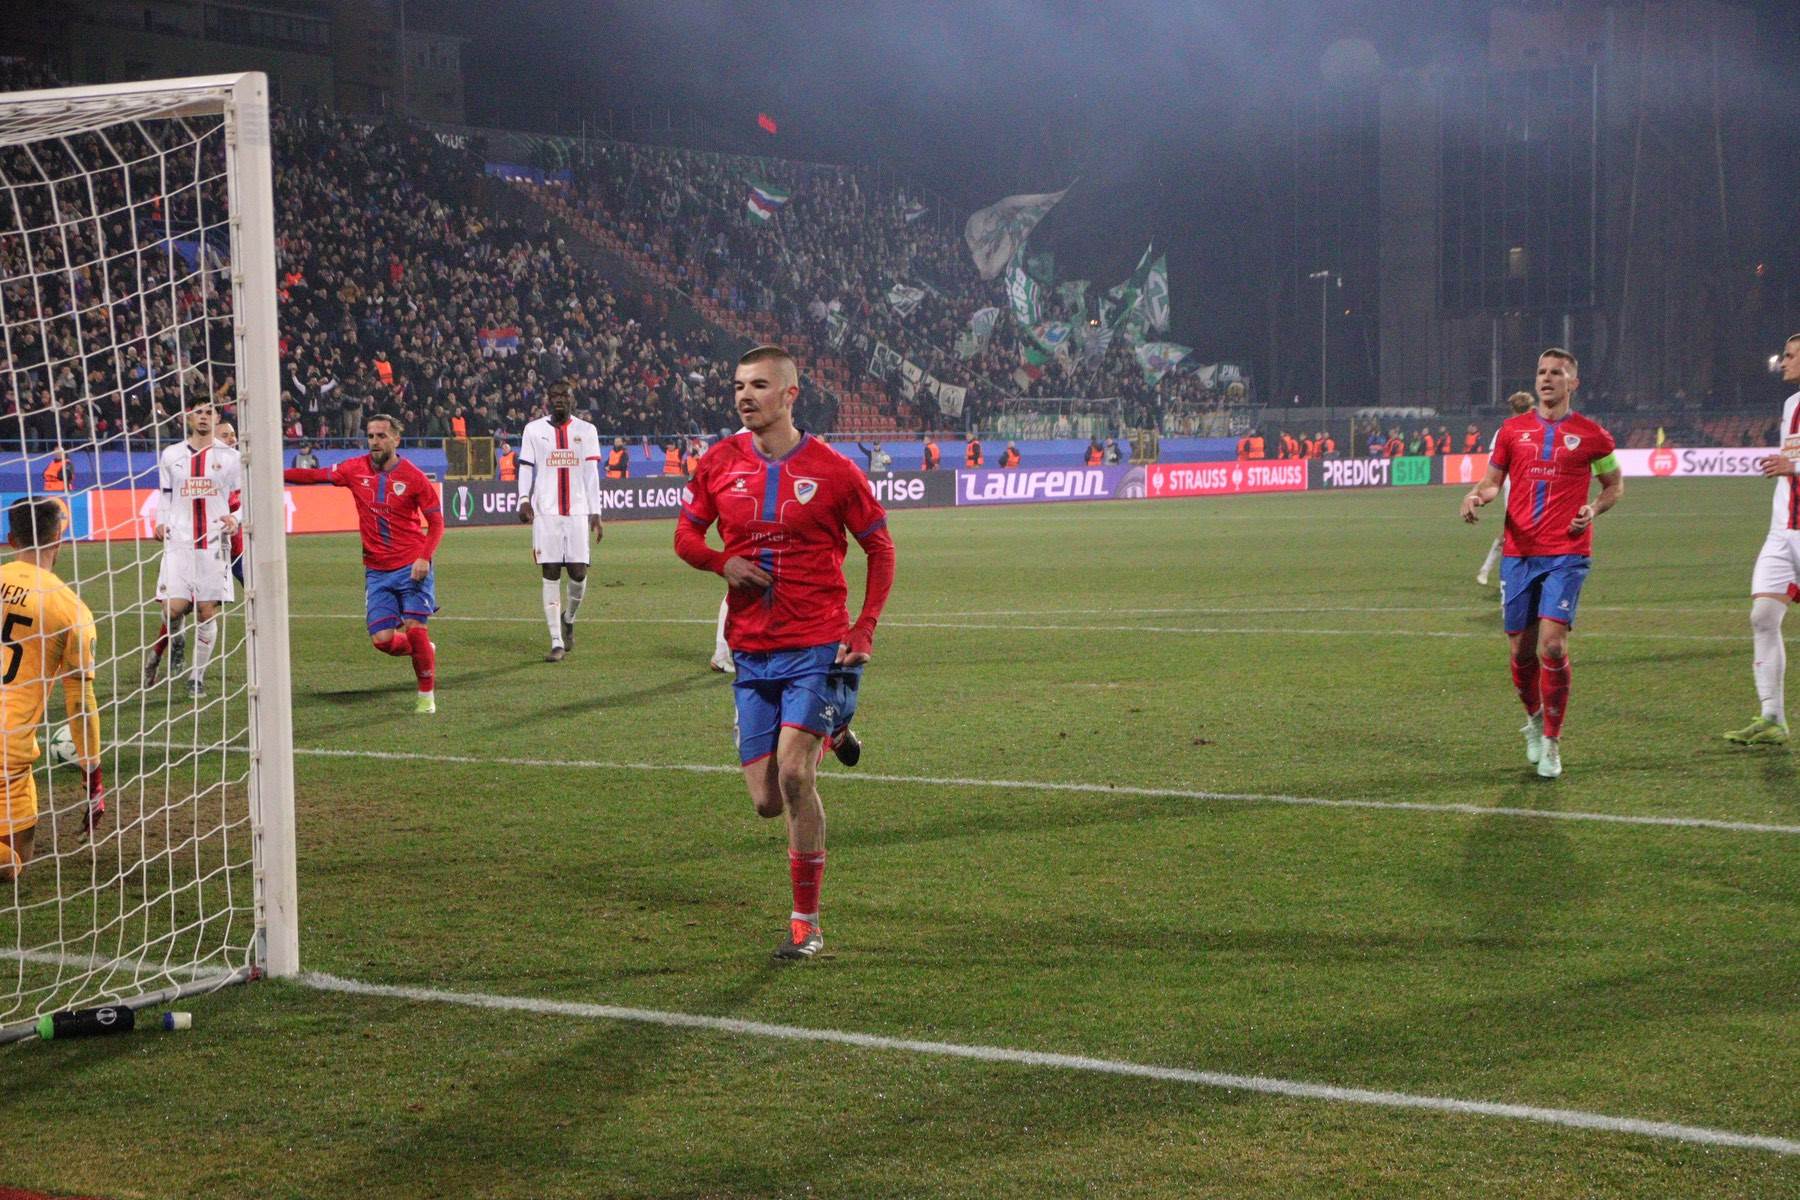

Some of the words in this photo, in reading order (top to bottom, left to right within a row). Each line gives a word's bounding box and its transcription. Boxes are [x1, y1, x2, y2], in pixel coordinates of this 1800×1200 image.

[1169, 468, 1227, 490] STRAUSS
[1247, 464, 1302, 486] STRAUSS
[1323, 459, 1390, 487] PREDICT
